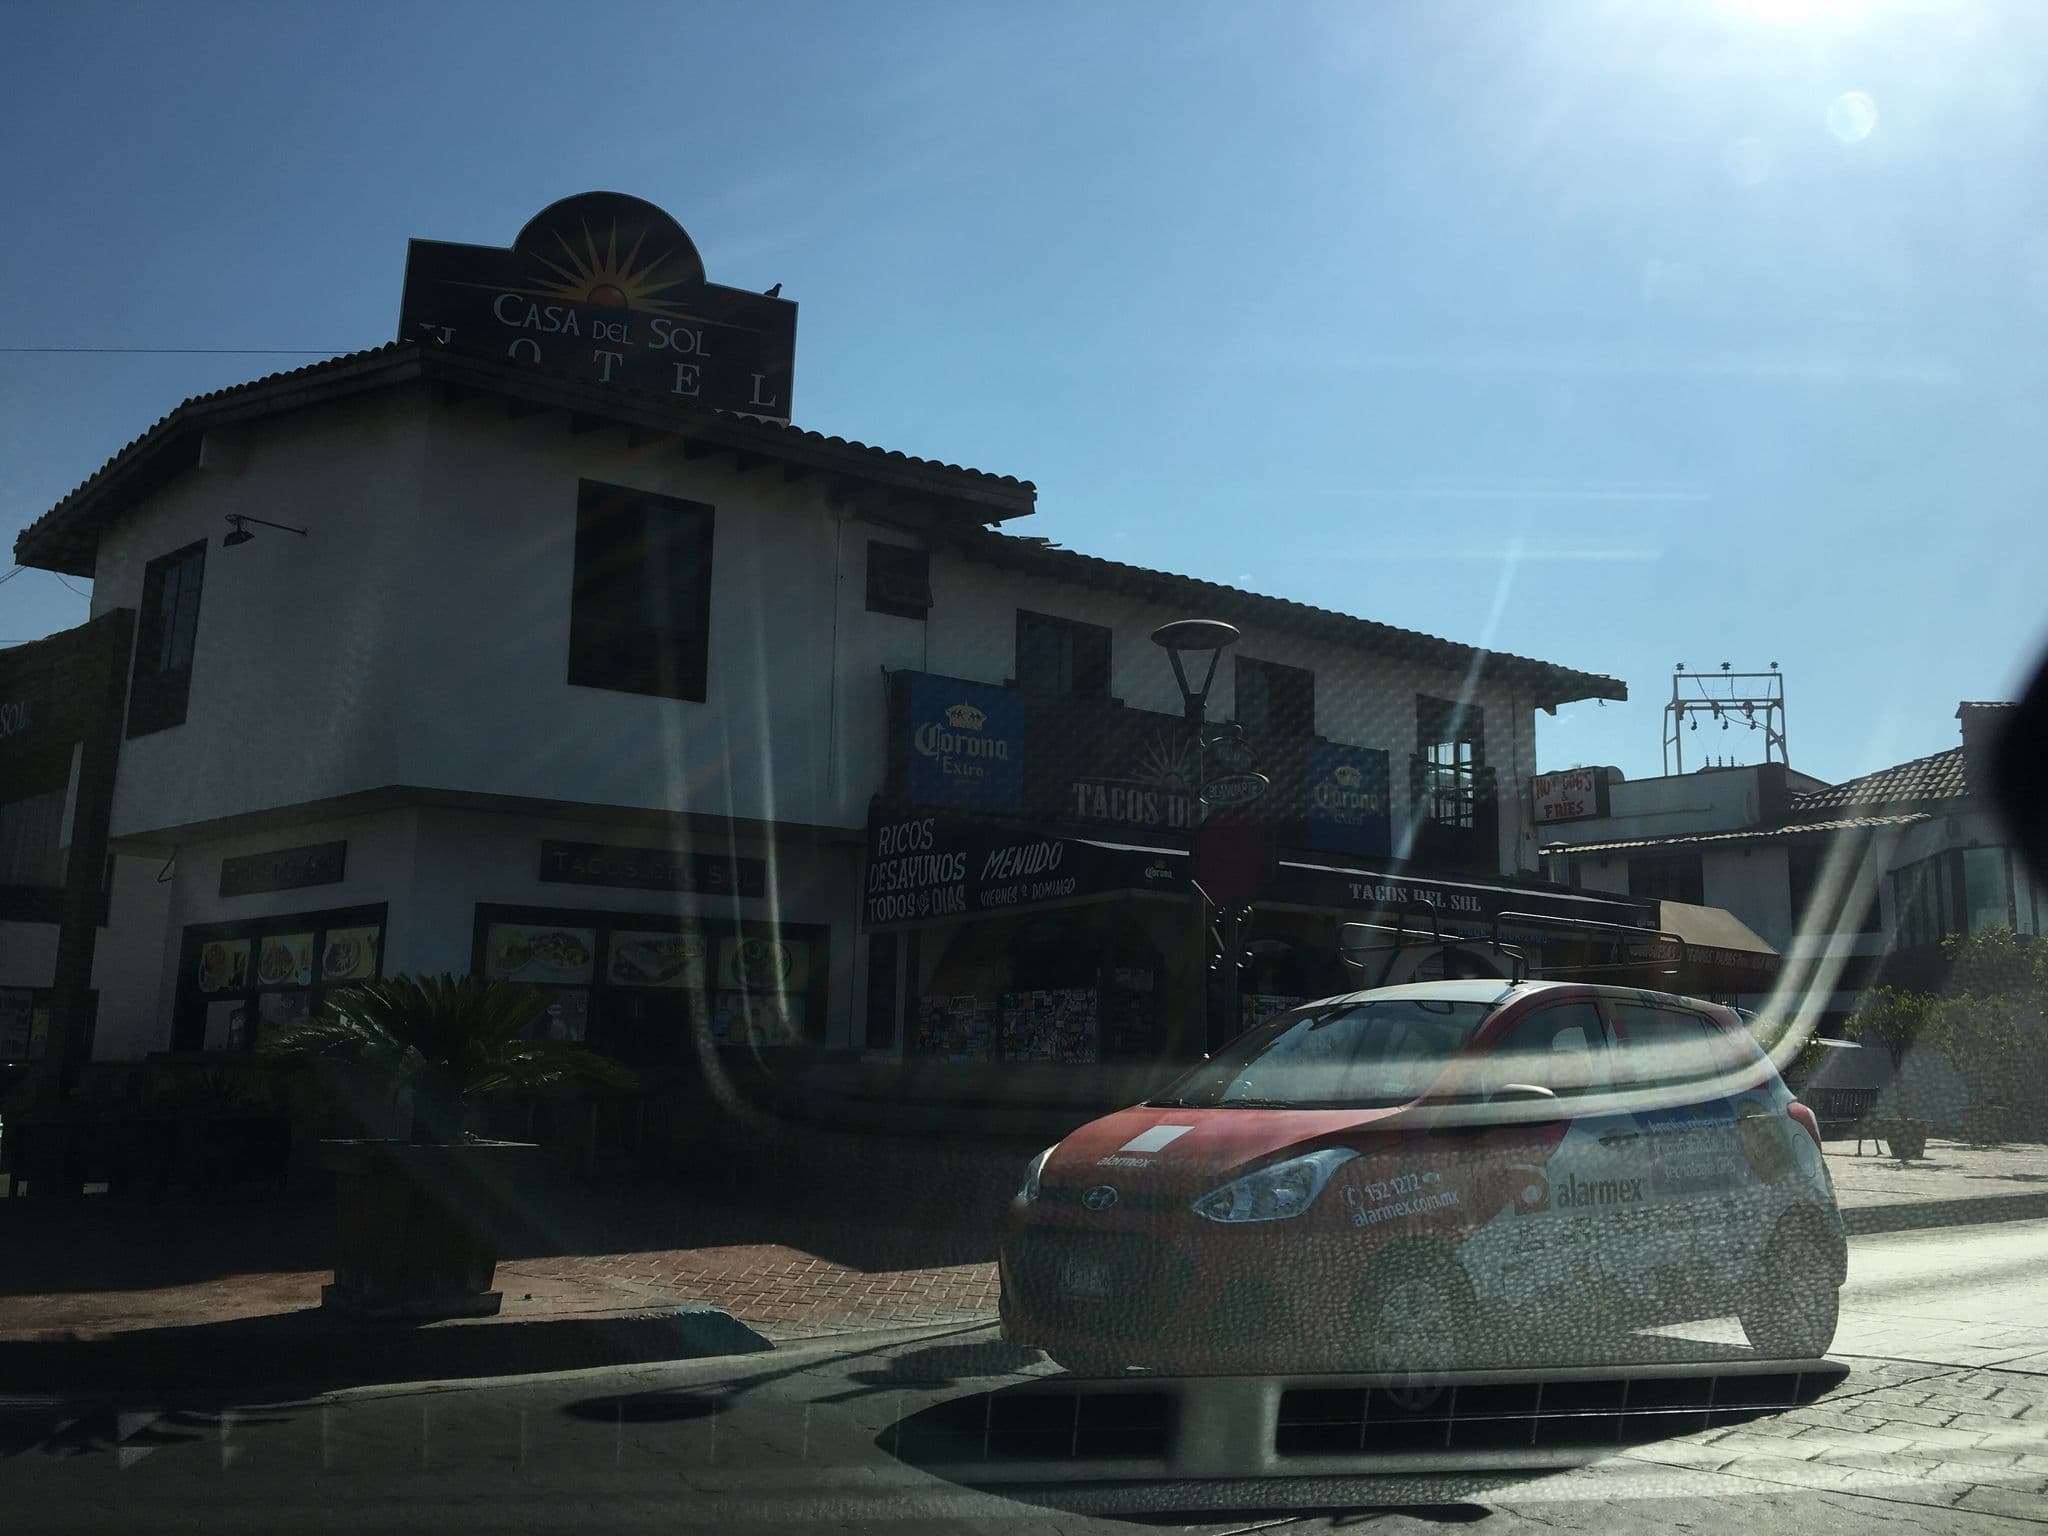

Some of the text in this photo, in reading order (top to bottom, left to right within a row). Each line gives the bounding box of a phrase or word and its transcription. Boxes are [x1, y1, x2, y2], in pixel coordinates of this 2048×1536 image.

[493, 293, 580, 336] CASA
[648, 318, 712, 358] SOL
[914, 721, 1008, 762] Corona
[943, 756, 984, 777] Extra
[1072, 783, 1159, 825] TACOS
[878, 816, 936, 857] RICOS
[868, 851, 968, 894] DESAYUNOS
[980, 840, 1065, 881] MENUDO
[868, 892, 916, 924] TODOS
[931, 883, 967, 915] DIAS
[980, 886, 1018, 907] VIERNES
[1032, 877, 1076, 901] DOMINGO
[1348, 882, 1482, 912] TACOS DEL SOL
[1353, 1191, 1459, 1227] alarmex.com.mx
[1365, 1180, 1391, 1202] 152
[1558, 1173, 1644, 1208] alarmex
